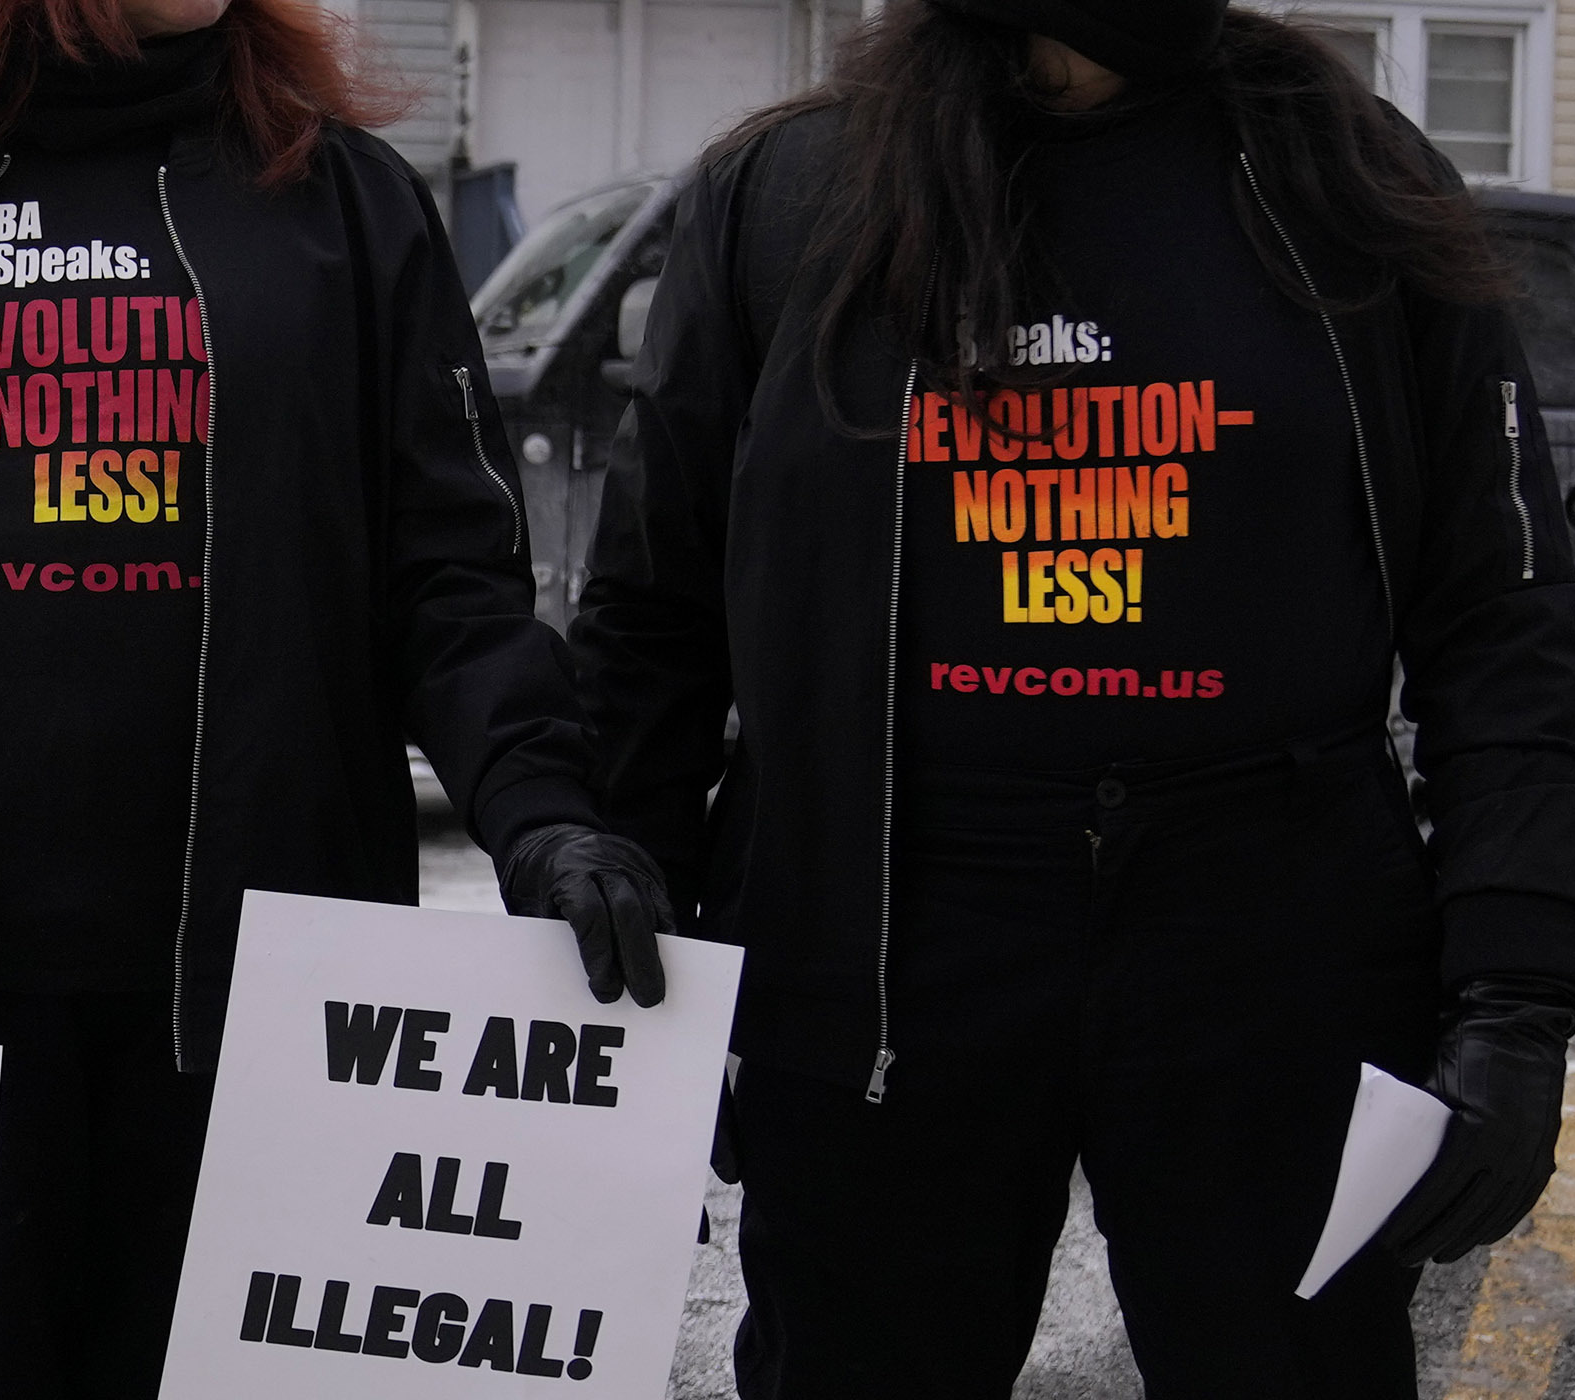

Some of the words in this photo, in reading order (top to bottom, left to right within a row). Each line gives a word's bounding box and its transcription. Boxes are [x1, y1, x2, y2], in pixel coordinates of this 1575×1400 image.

[33, 449, 181, 524] LESS!
[953, 463, 1190, 543] NOTHING
[1002, 548, 1144, 624] LESS!
[930, 662, 1225, 698] revcom.us
[324, 1000, 452, 1092] WE
[461, 1015, 625, 1108] ARE
[366, 1151, 522, 1241] ALL
[239, 1270, 604, 1382] ILLEGAL!
